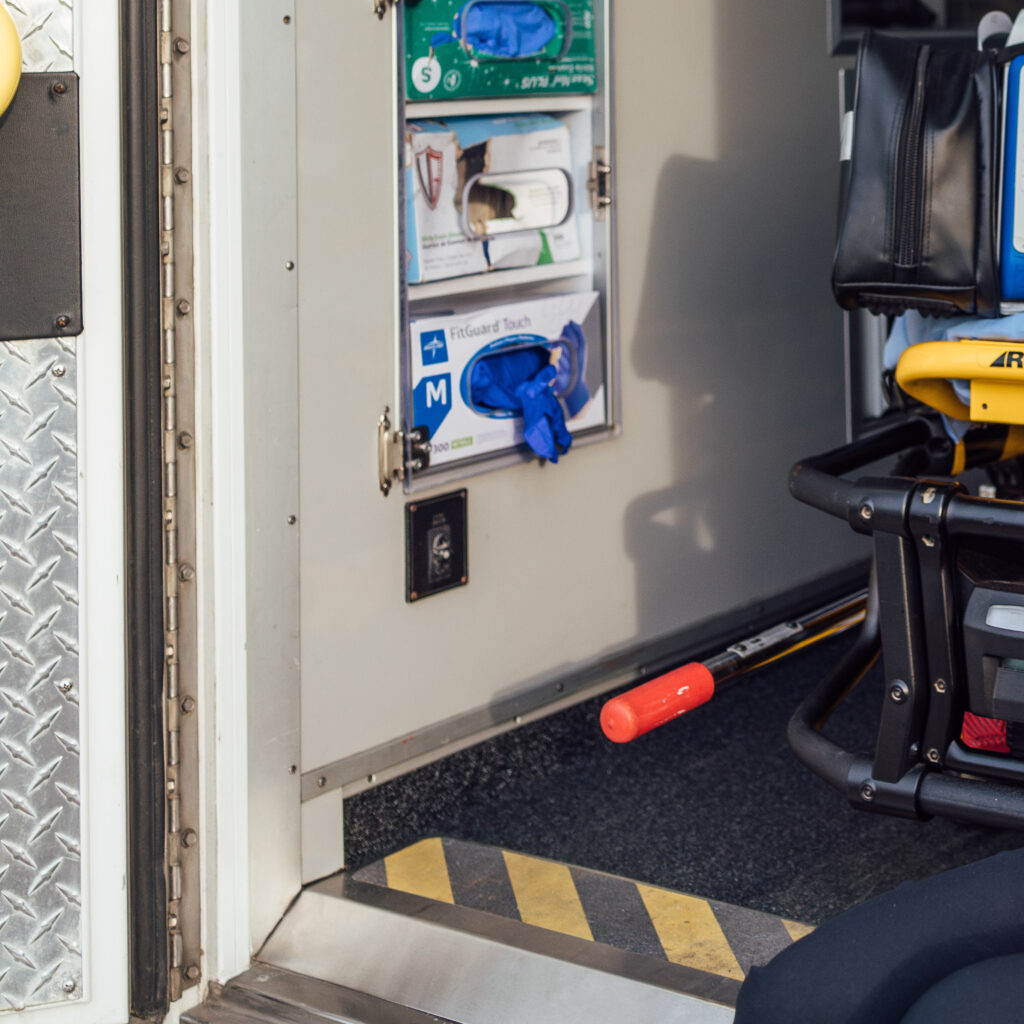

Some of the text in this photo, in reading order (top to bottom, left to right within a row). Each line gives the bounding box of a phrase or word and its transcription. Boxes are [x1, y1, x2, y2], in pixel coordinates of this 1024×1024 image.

[420, 66, 433, 83] S
[450, 316, 531, 340] FitGuard Touch
[425, 378, 448, 409] M
